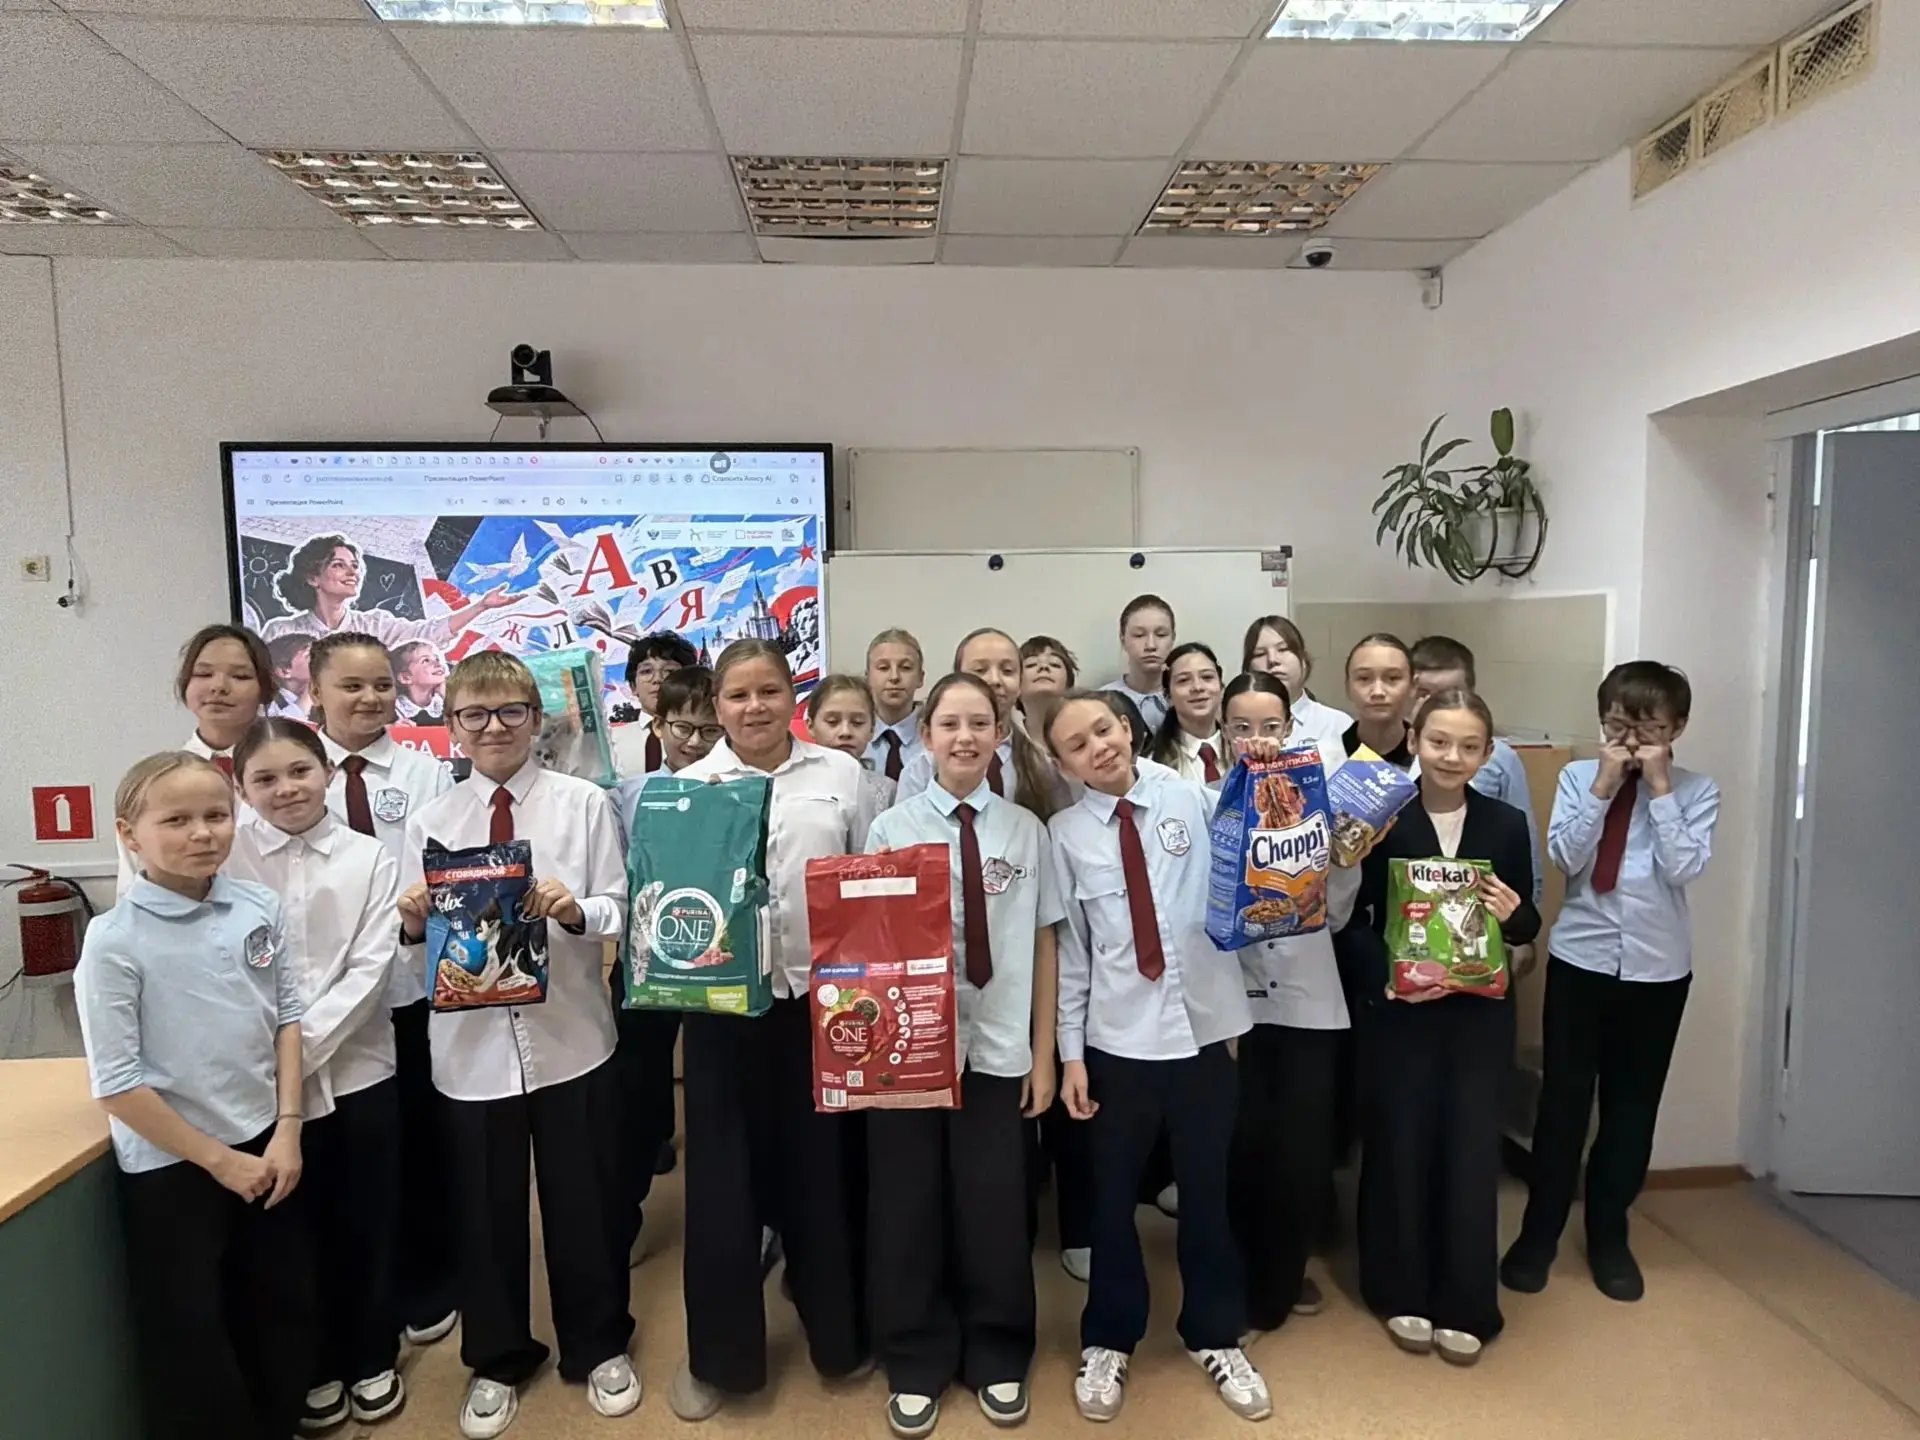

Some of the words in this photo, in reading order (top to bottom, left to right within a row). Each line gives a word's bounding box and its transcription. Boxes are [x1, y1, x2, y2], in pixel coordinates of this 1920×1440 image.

[676, 586, 706, 629] Я
[1251, 822, 1325, 870] Chappi
[657, 915, 713, 942] ONE
[830, 1025, 869, 1042] ONE
